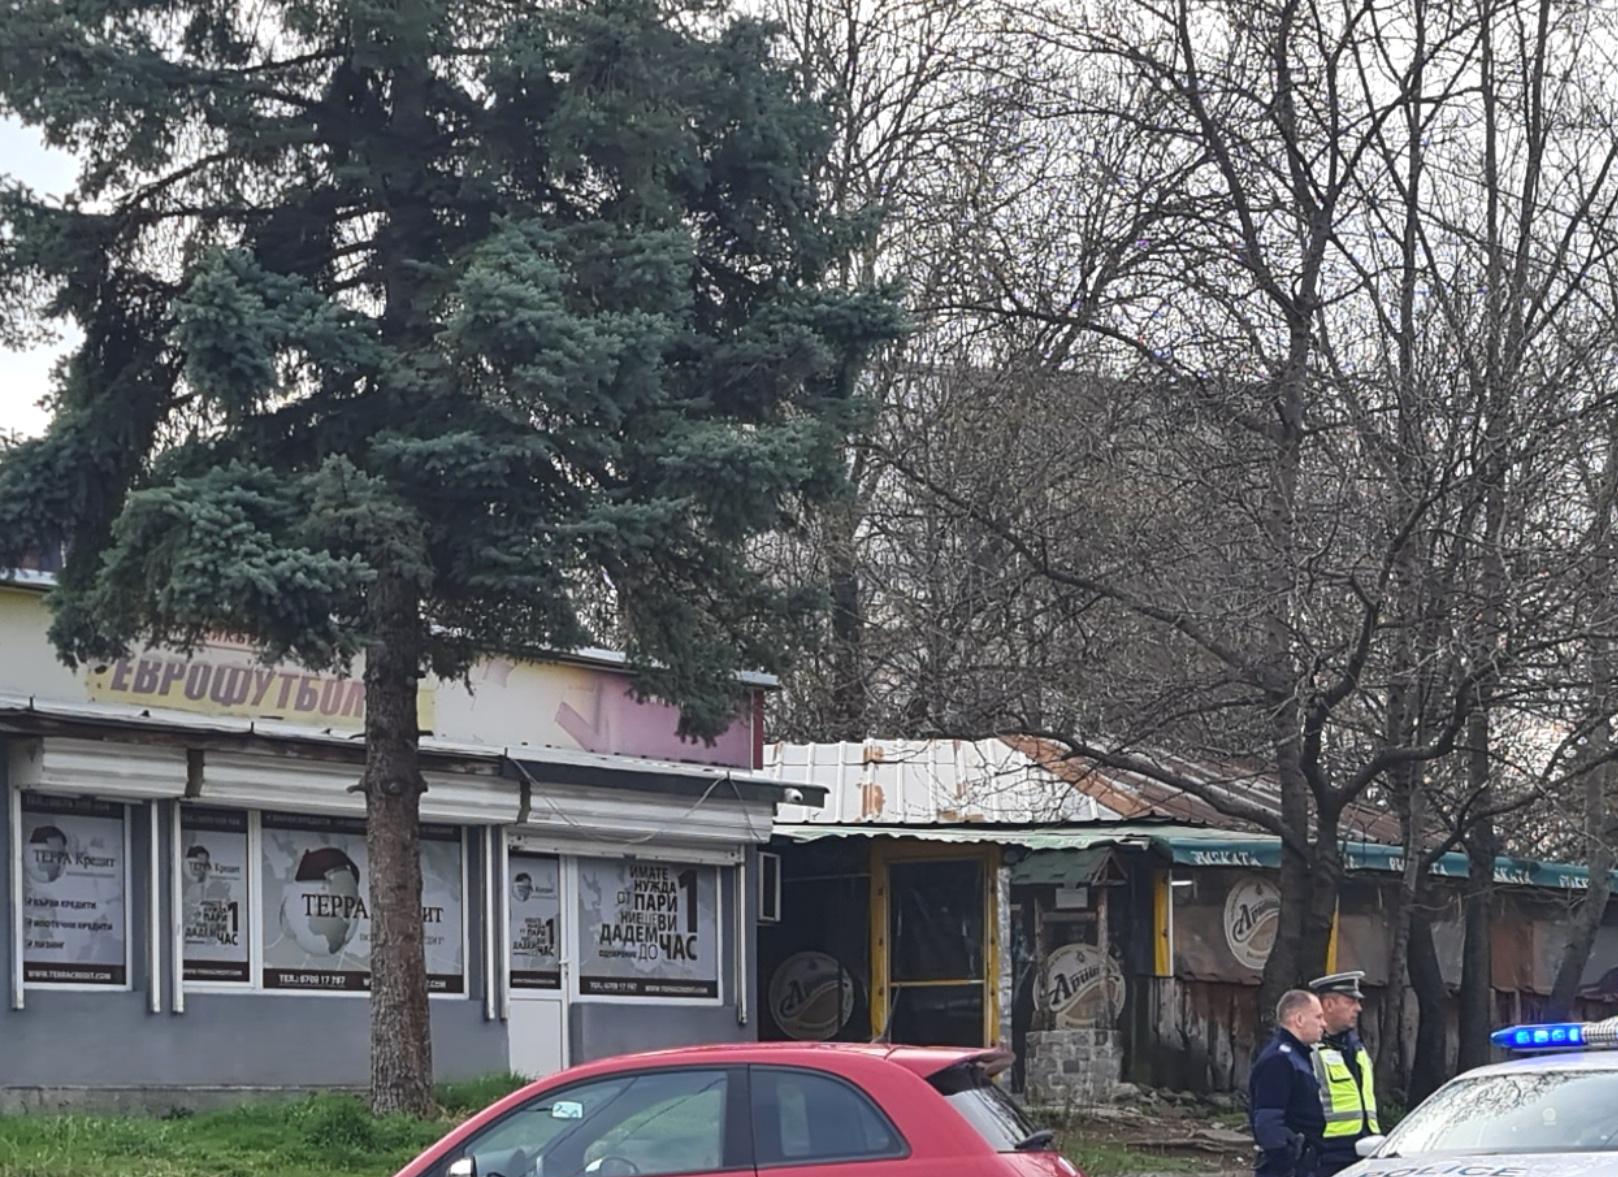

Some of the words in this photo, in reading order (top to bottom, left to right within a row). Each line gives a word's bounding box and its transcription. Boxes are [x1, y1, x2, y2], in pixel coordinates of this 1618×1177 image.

[629, 865, 668, 880] ИМАТЕ
[634, 880, 677, 894] НУЖДА
[302, 893, 369, 920] ТЕРРА
[616, 890, 631, 904] ОТ
[634, 893, 678, 912] ПАРИ
[677, 869, 698, 933] 1
[600, 923, 658, 946] ДАДЕМ
[638, 943, 658, 960] ДО
[659, 934, 698, 961] ЧАС
